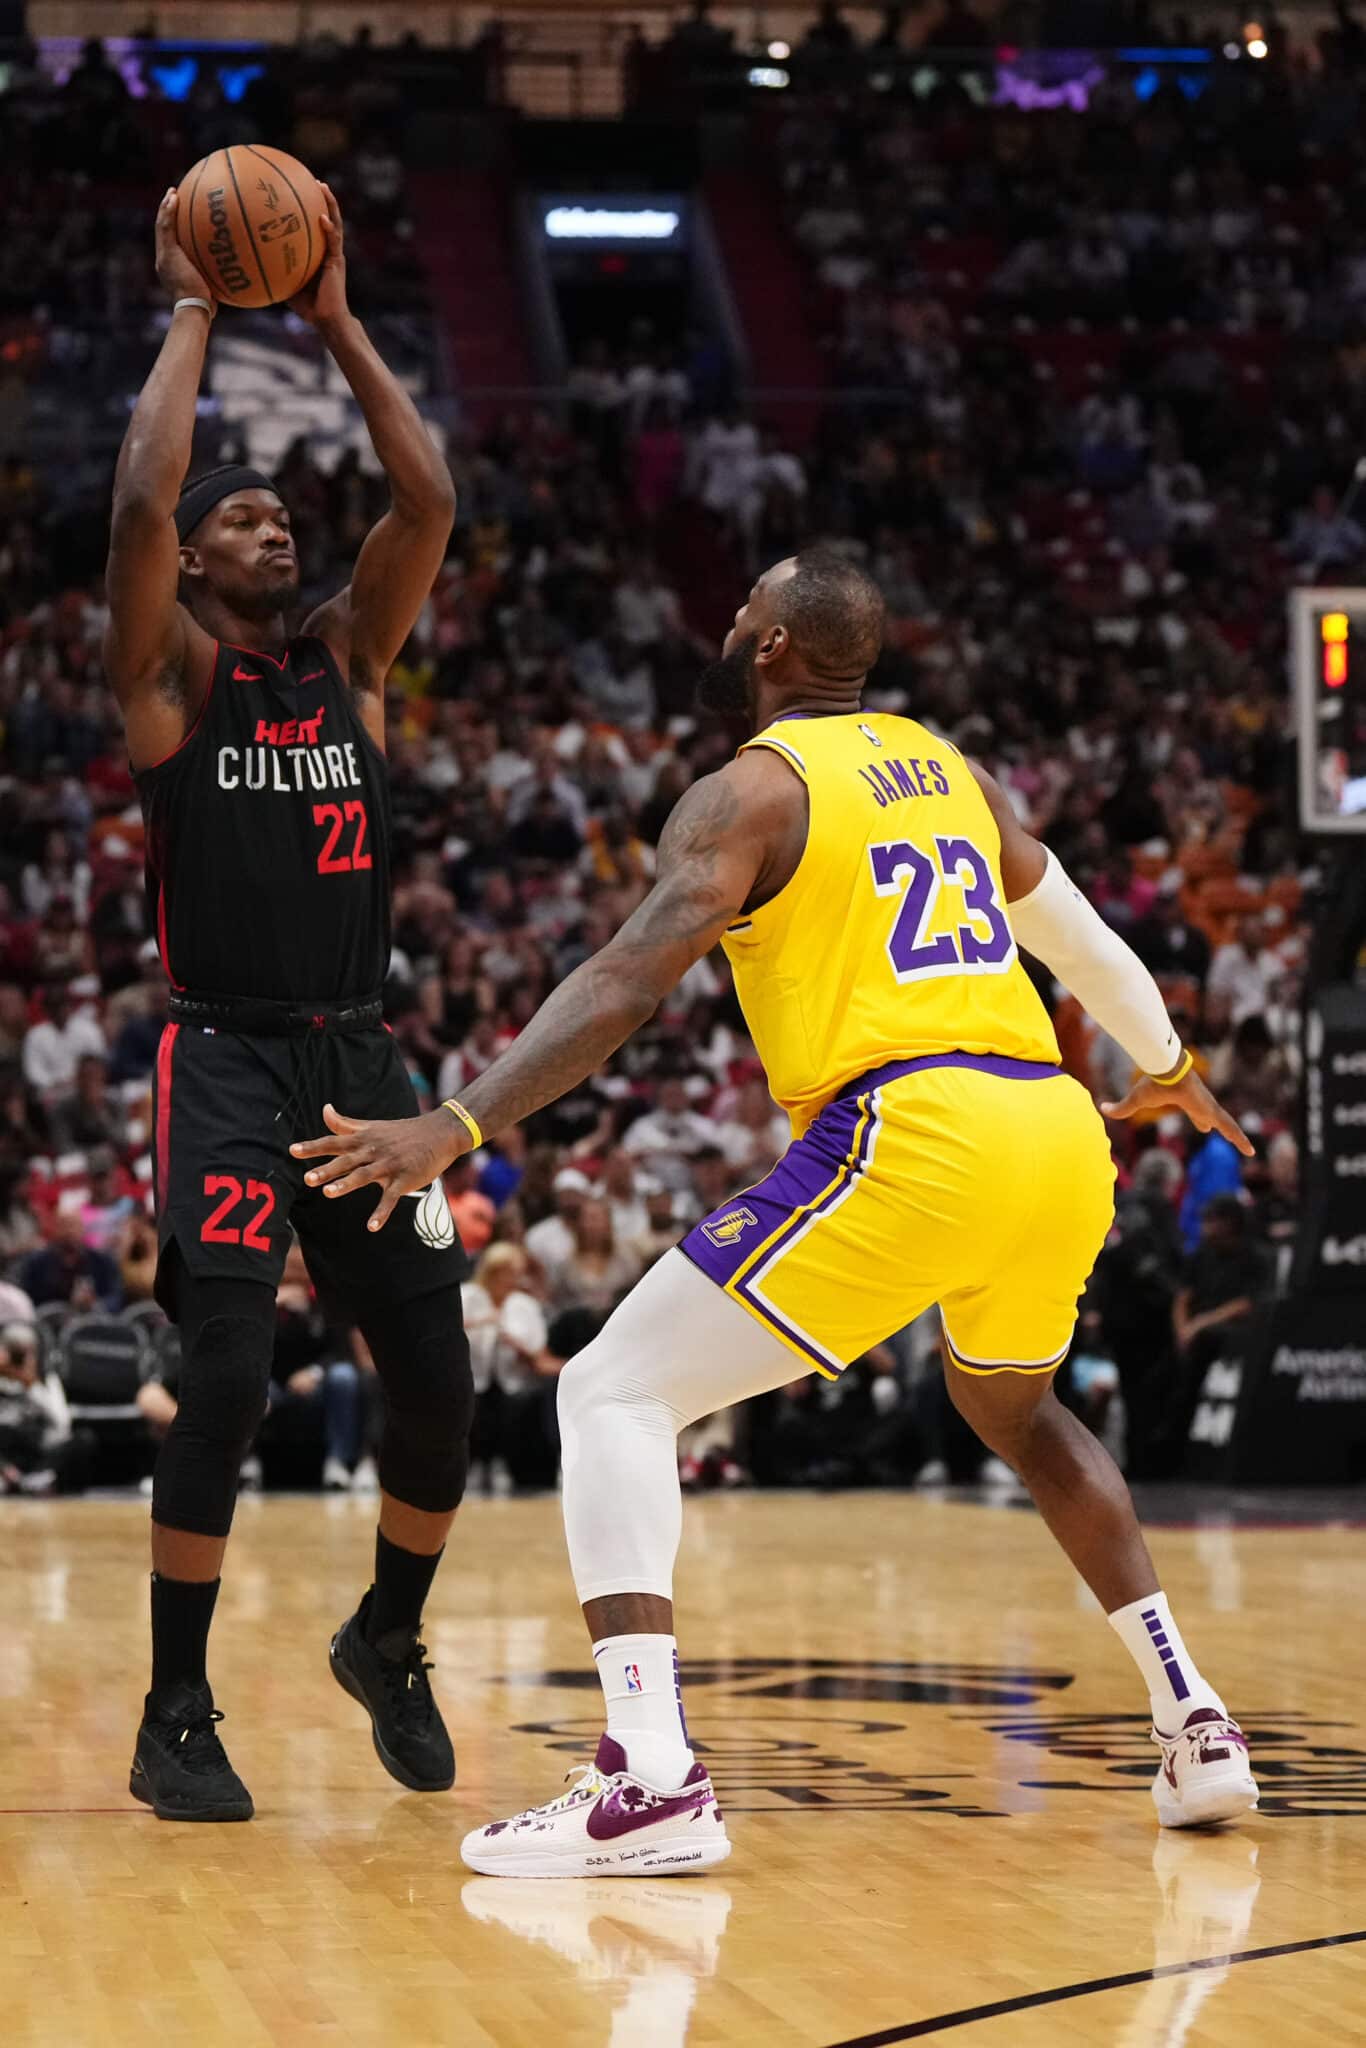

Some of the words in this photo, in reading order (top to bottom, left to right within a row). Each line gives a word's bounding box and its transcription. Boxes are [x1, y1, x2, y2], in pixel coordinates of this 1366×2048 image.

[207, 186, 251, 294] Wilson
[217, 742, 361, 792] CULTURE
[858, 758, 950, 808] JAMES
[312, 800, 373, 875] 22
[867, 833, 1018, 984] 23
[200, 1174, 276, 1252] 22
